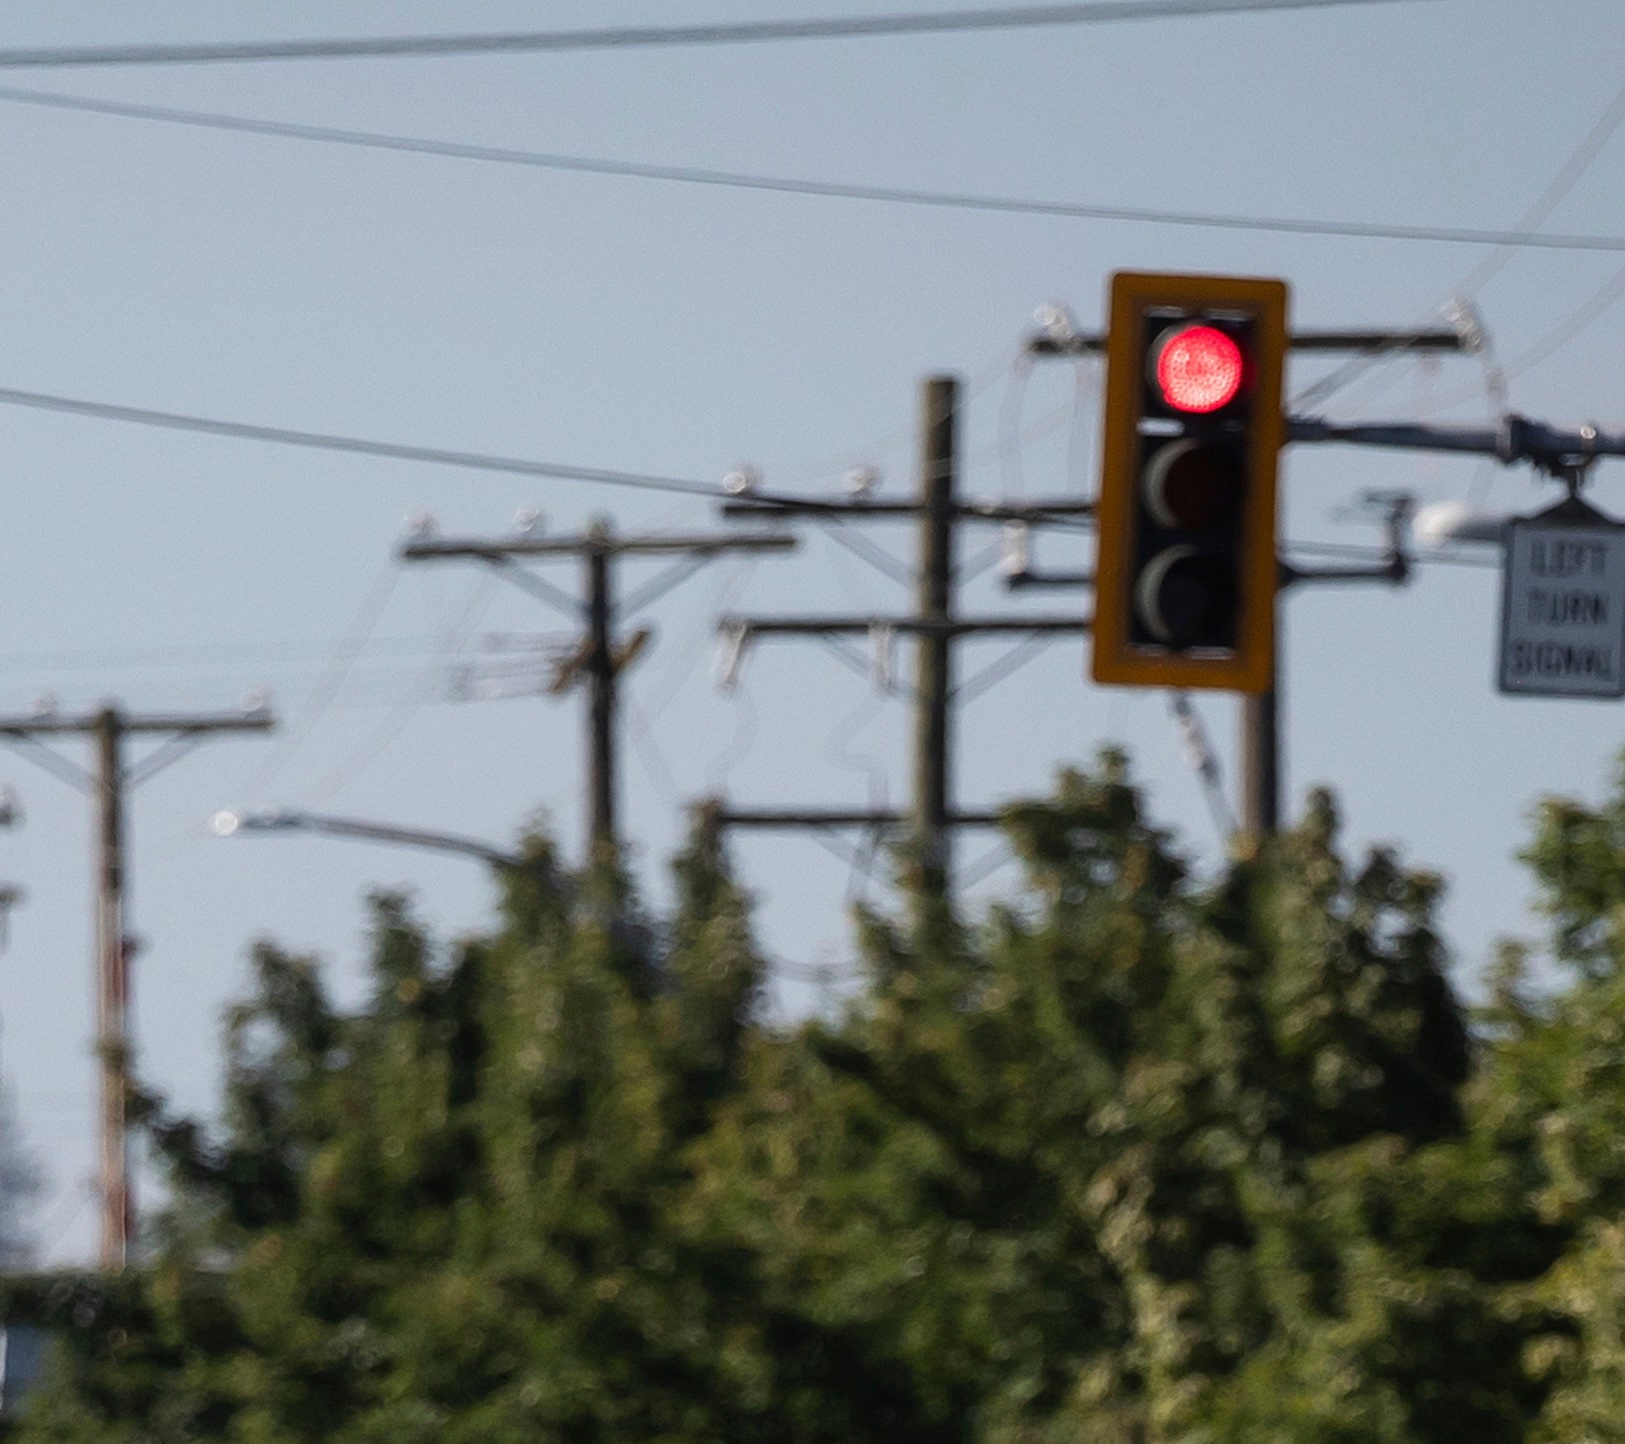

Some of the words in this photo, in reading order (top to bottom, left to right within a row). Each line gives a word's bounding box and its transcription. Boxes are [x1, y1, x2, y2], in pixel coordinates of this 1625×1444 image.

[1530, 539, 1608, 578] LEFT
[1527, 591, 1608, 624] TURN
[1510, 641, 1611, 680] SIGNAL
